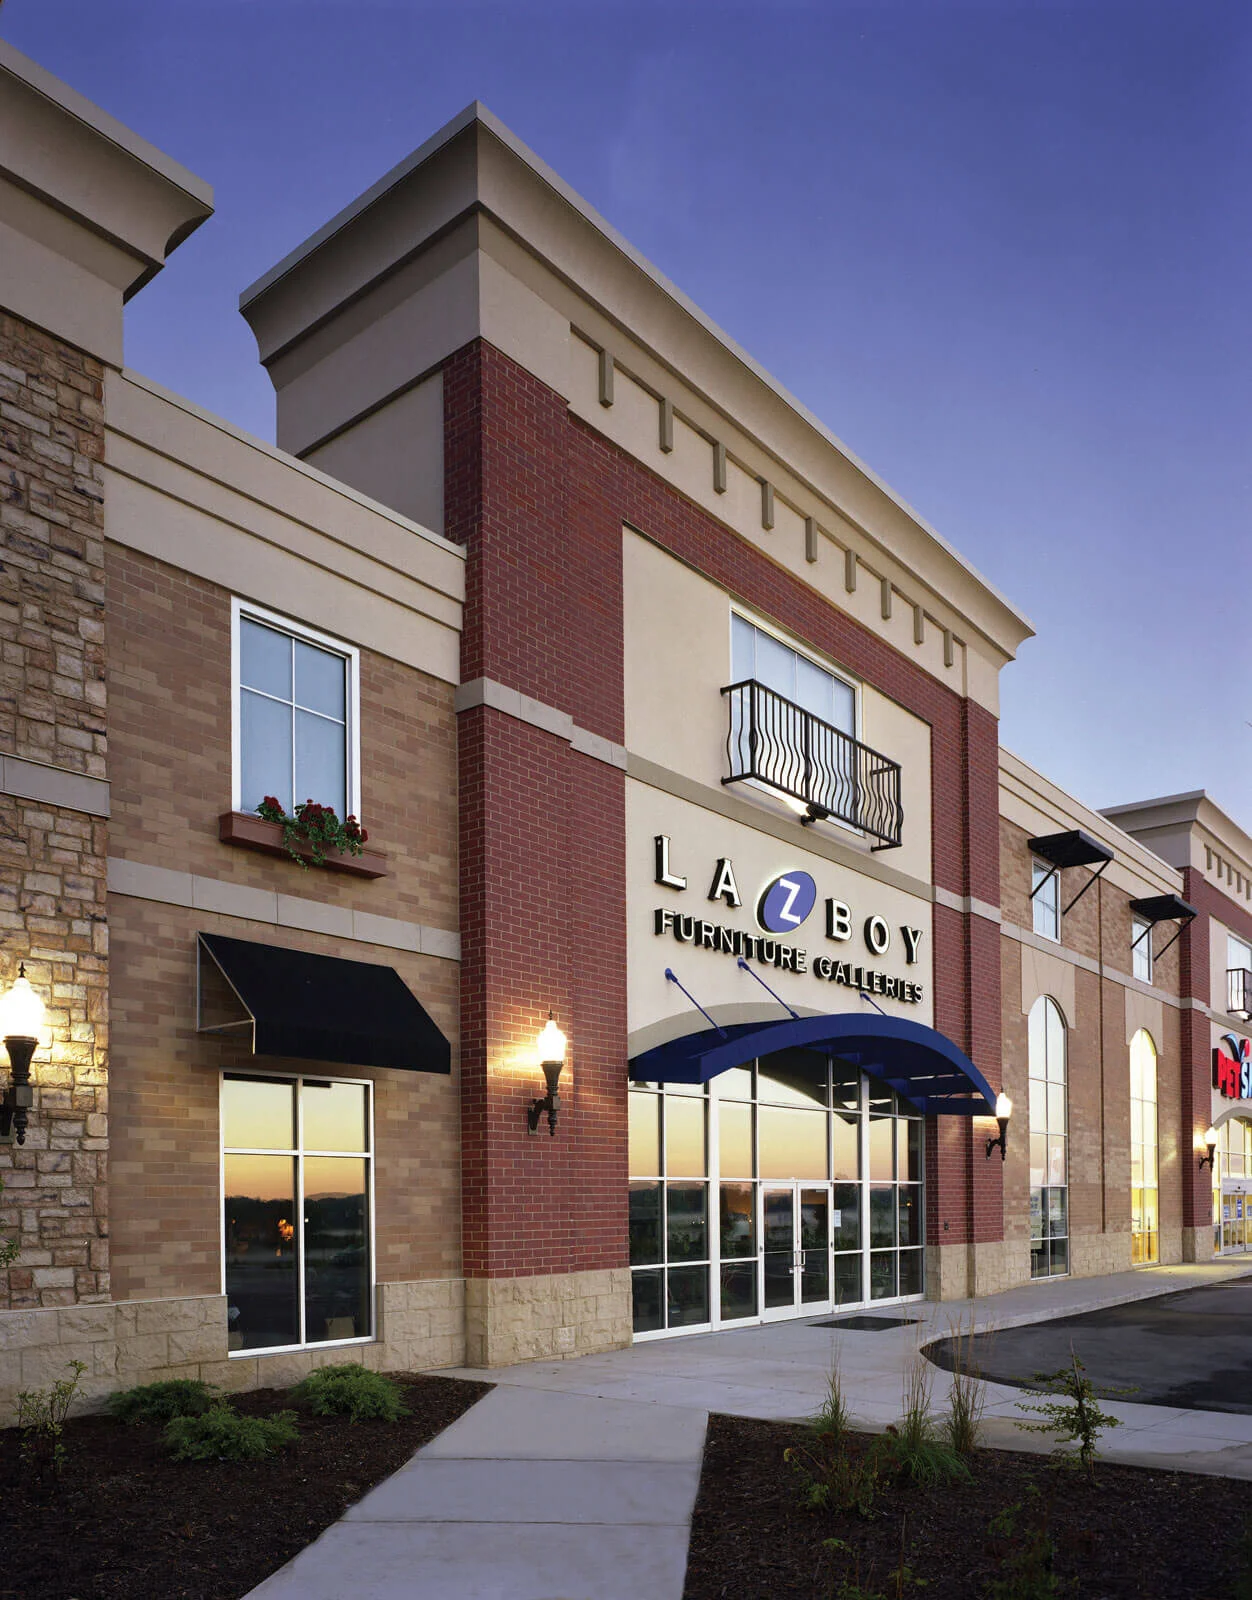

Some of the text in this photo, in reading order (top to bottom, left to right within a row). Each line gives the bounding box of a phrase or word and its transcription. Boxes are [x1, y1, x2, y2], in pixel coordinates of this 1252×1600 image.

[654, 835, 742, 907] LA
[825, 897, 923, 964] BOY
[654, 908, 923, 1003] FURNITURE GALLERIES
